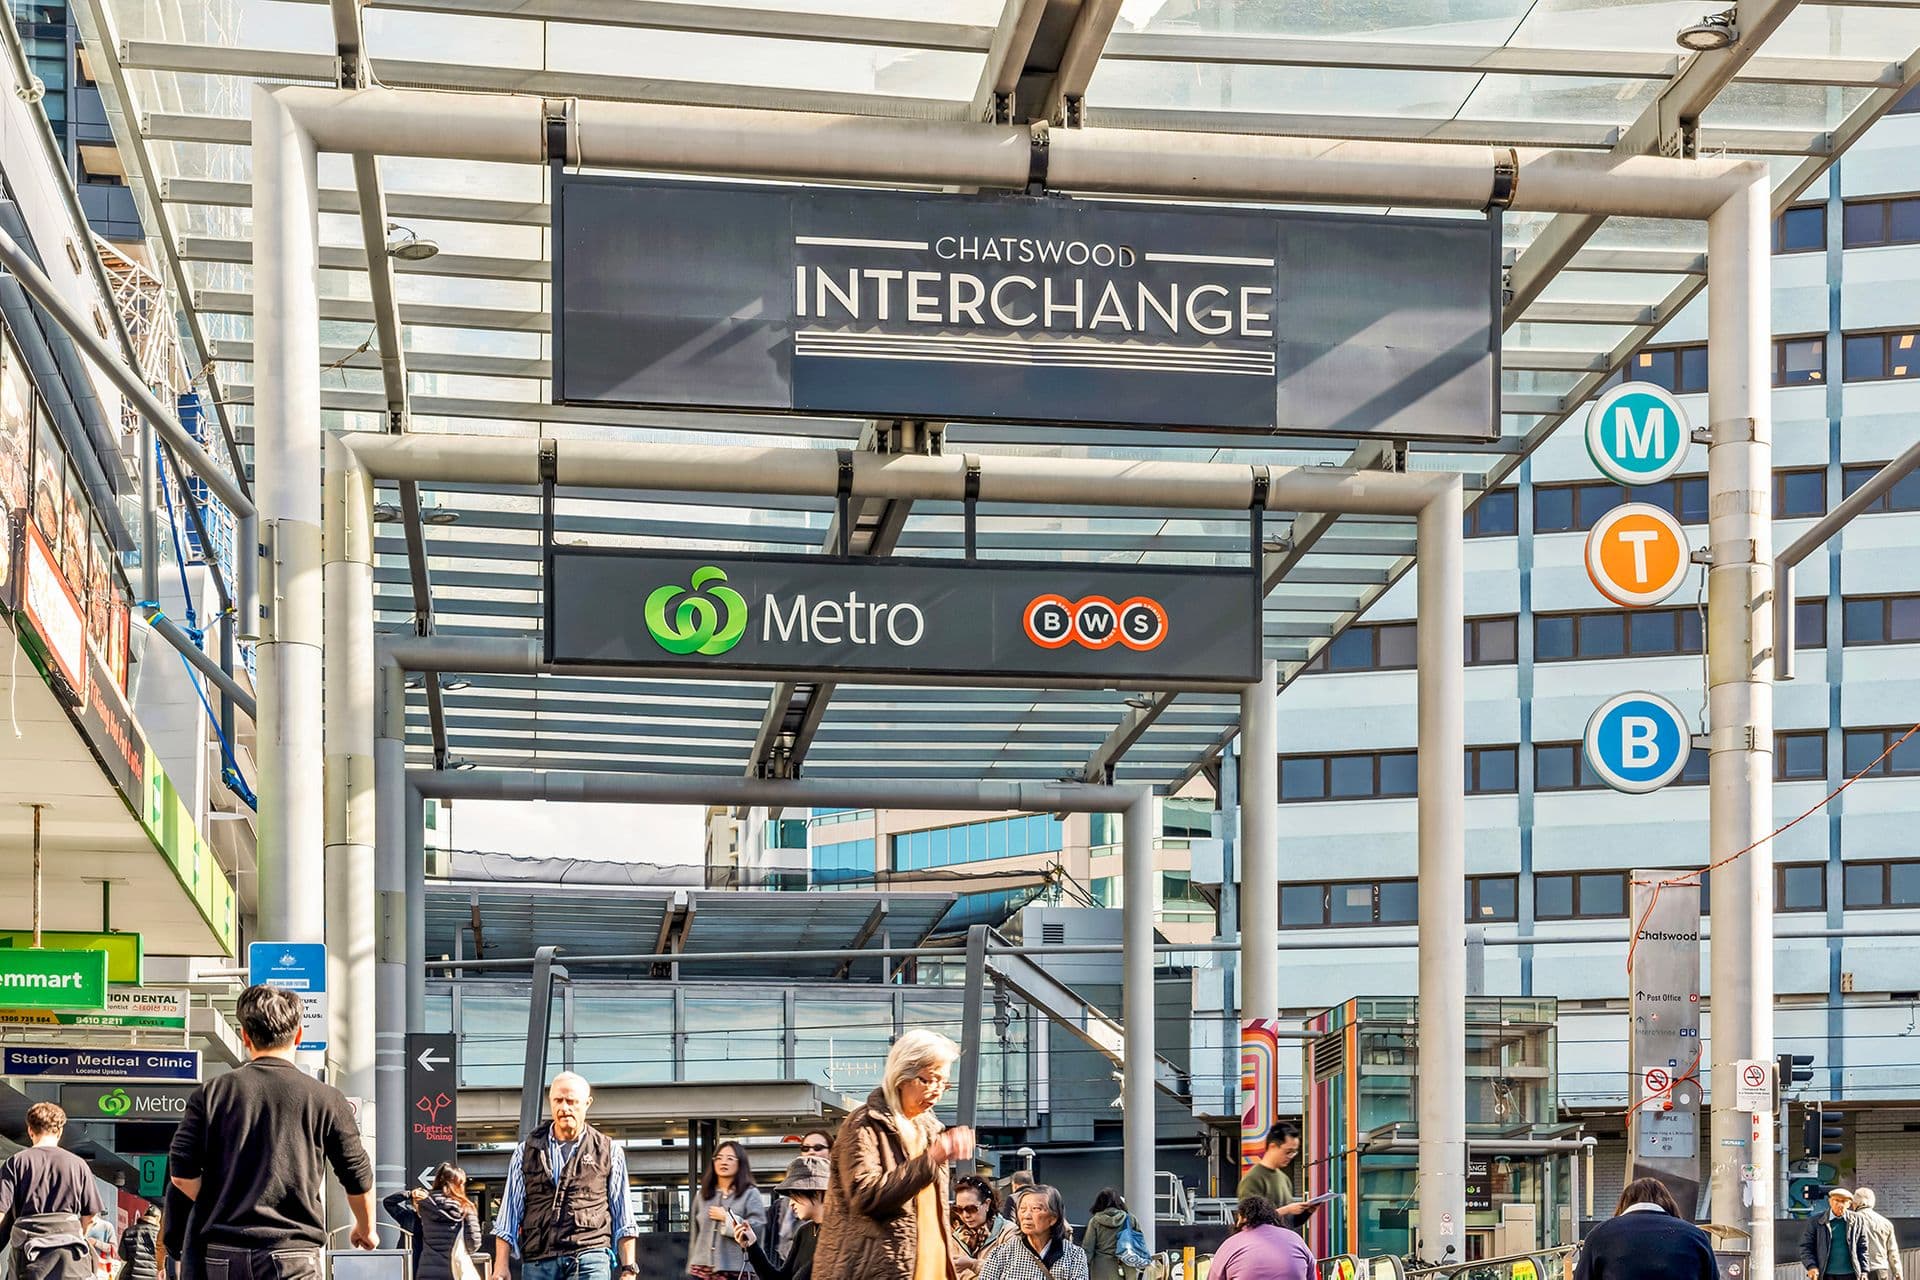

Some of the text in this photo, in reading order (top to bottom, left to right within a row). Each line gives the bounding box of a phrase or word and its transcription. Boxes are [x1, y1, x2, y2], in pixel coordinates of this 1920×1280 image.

[935, 236, 1136, 268] CHATSWOOD
[795, 264, 1275, 338] INTERCHANGE
[1615, 406, 1665, 460] M
[1618, 530, 1658, 584] T
[763, 590, 924, 647] Metro
[1621, 716, 1660, 768] B
[1638, 930, 1697, 941] Chatswood
[0, 971, 83, 989] mmart
[133, 994, 178, 1004] DENTAL
[1647, 993, 1681, 1002] Post Office
[76, 1016, 123, 1025] 9410 2211
[11, 1053, 192, 1068] Station Medical Clinic
[135, 1095, 187, 1112] Metro
[414, 1123, 453, 1133] District
[426, 1133, 453, 1141] Dining
[144, 1160, 155, 1183] G
